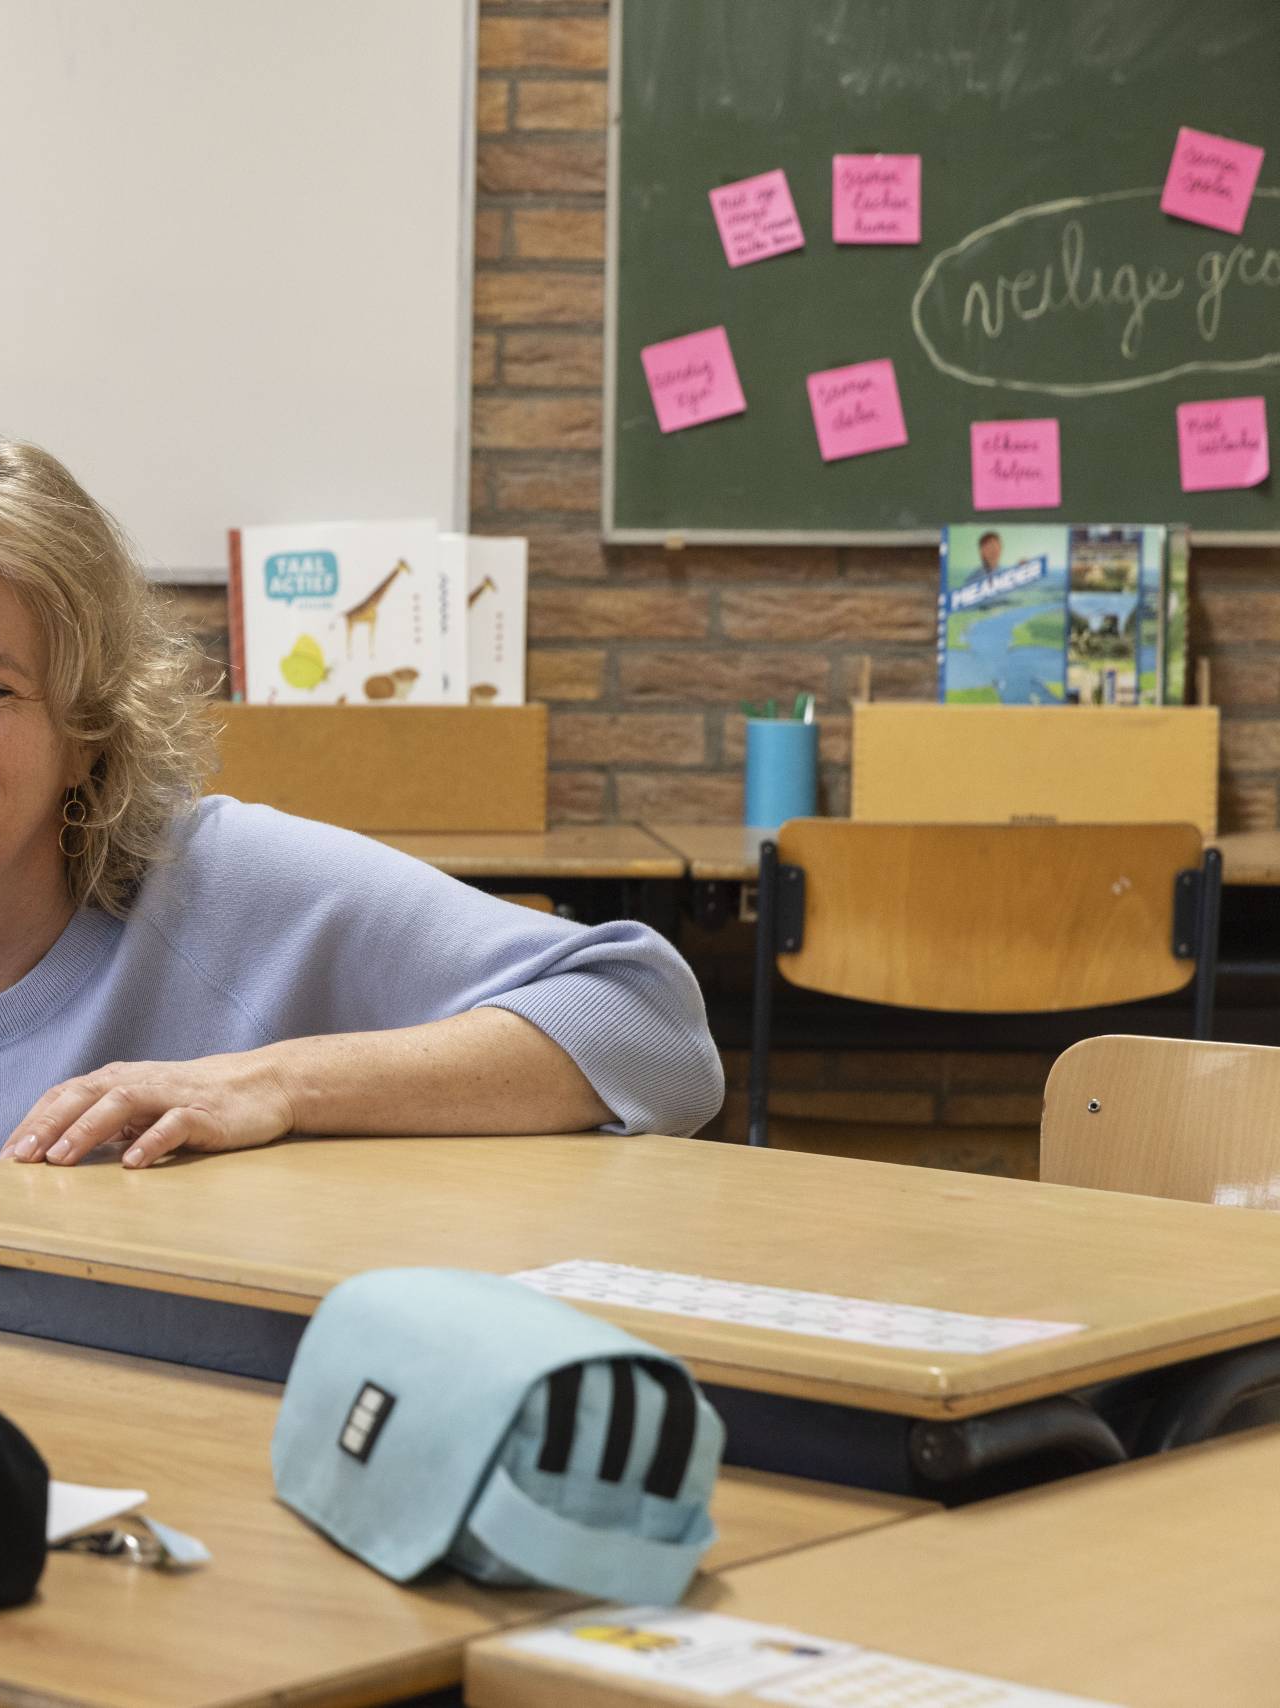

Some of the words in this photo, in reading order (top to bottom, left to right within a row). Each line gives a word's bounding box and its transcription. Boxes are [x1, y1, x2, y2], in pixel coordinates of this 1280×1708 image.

[962, 219, 1186, 359] veilige
[276, 556, 325, 577] TAAL
[269, 573, 335, 594] ACTIEF
